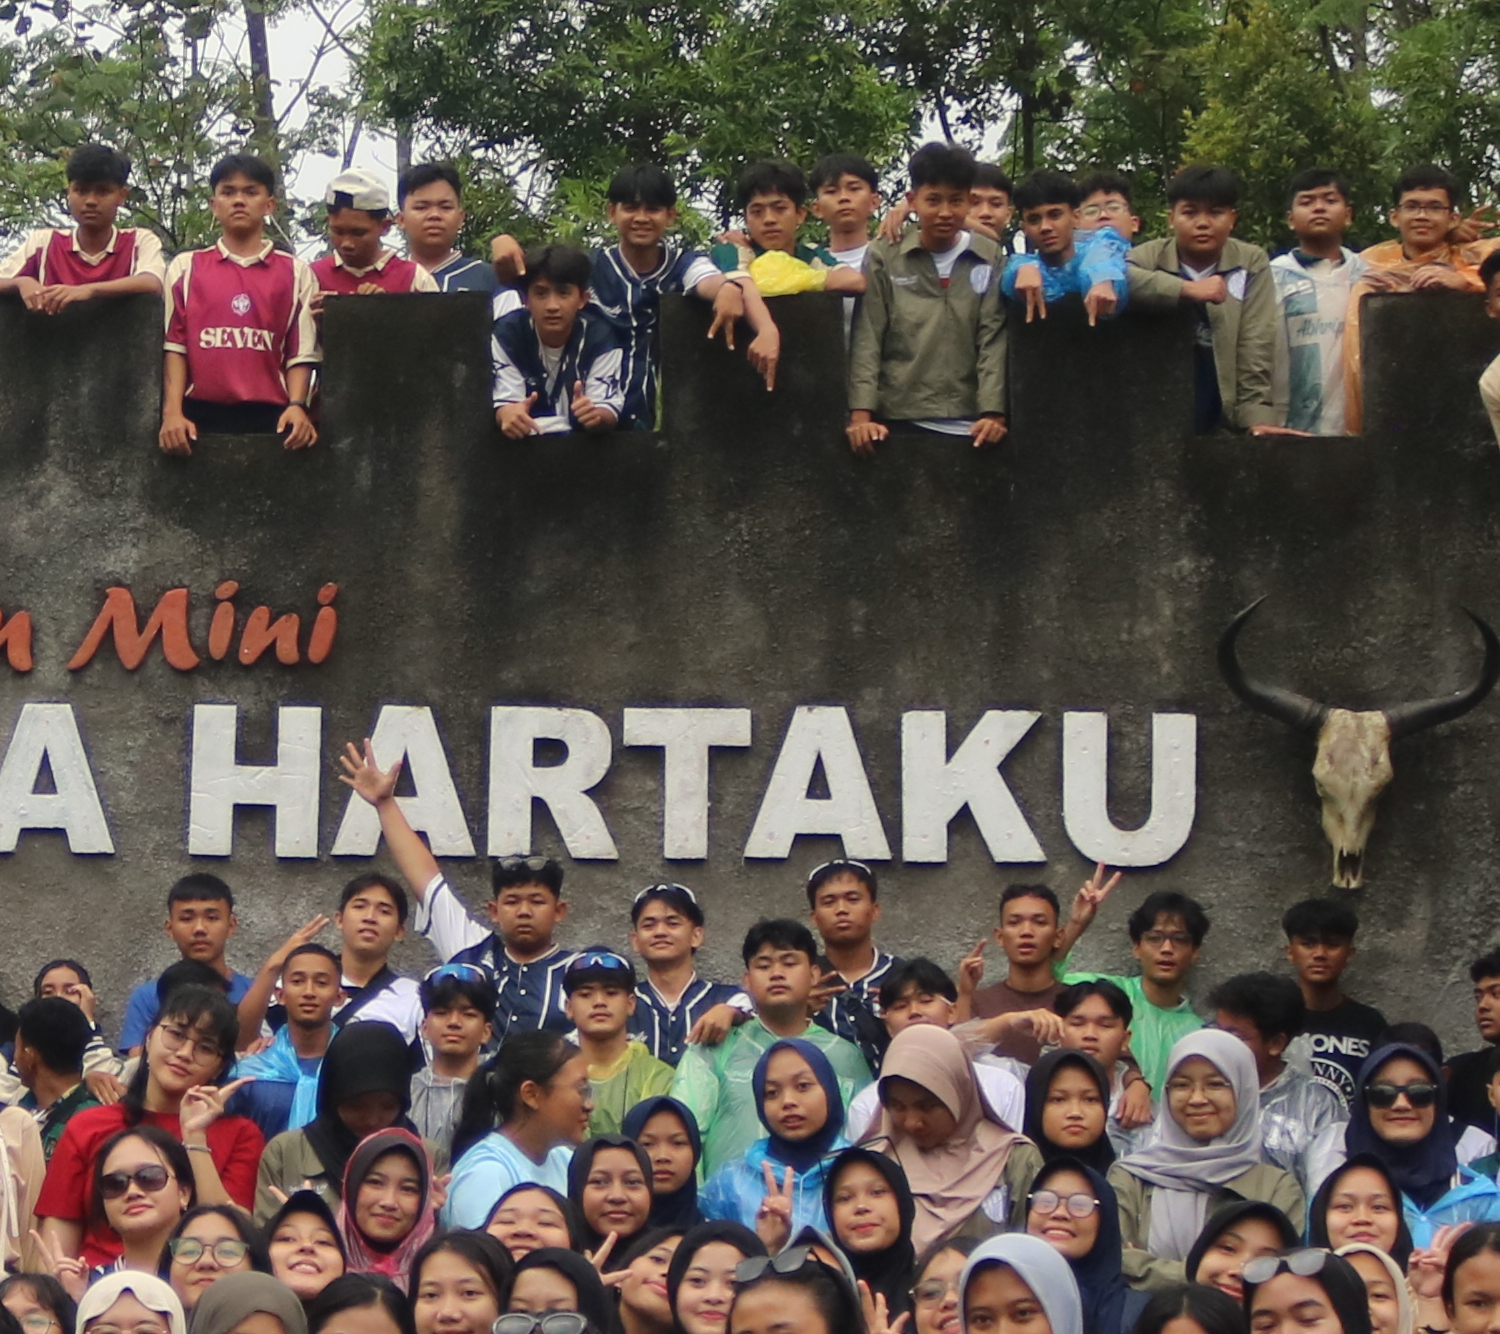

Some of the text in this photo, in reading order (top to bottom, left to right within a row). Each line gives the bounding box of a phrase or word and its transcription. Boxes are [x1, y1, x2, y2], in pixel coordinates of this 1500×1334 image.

[199, 326, 276, 352] SEVEN
[68, 580, 340, 671] Mini
[187, 703, 1198, 868] HARTAKU
[1309, 1034, 1371, 1058] ONES
